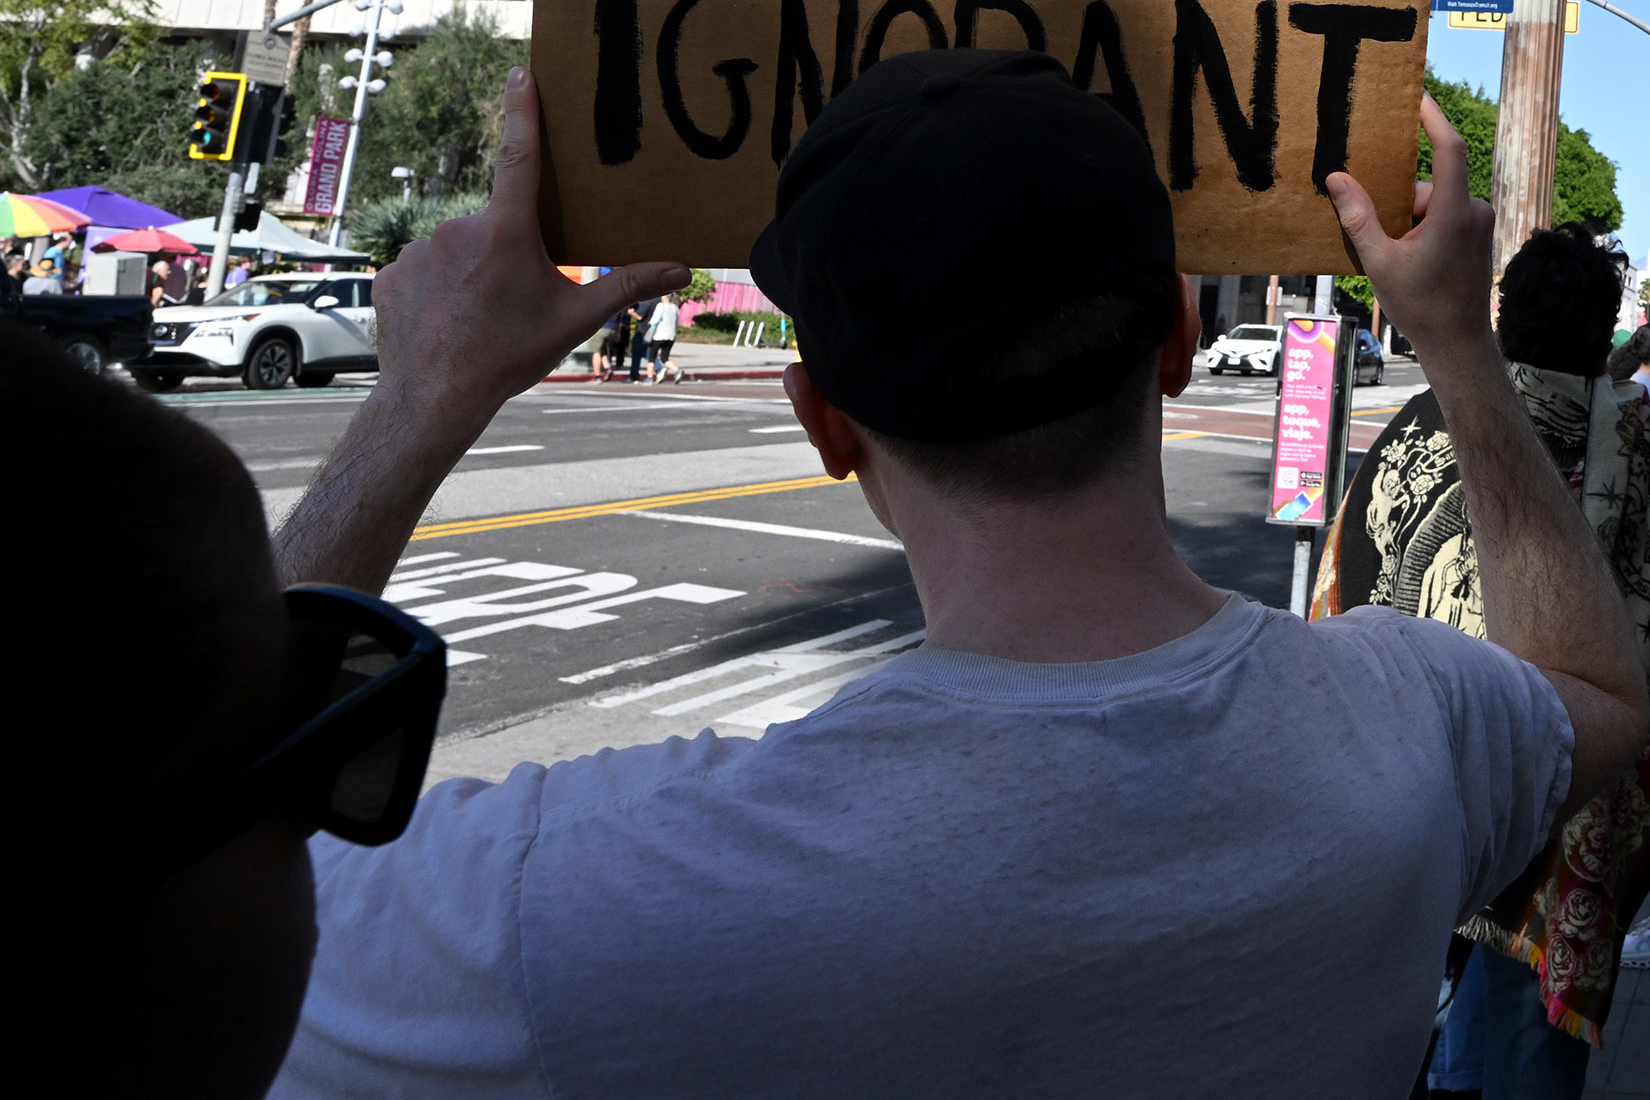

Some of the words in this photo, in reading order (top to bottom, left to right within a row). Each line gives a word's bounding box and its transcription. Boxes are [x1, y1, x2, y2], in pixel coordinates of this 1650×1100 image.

[323, 119, 348, 160] PARK
[313, 160, 338, 214] GRAND
[1288, 348, 1314, 360] app,
[1287, 359, 1311, 372] tap,
[1286, 370, 1306, 382] go.
[1283, 404, 1310, 416] app,
[1282, 415, 1321, 428] toque,
[1281, 426, 1313, 440] viaje.
